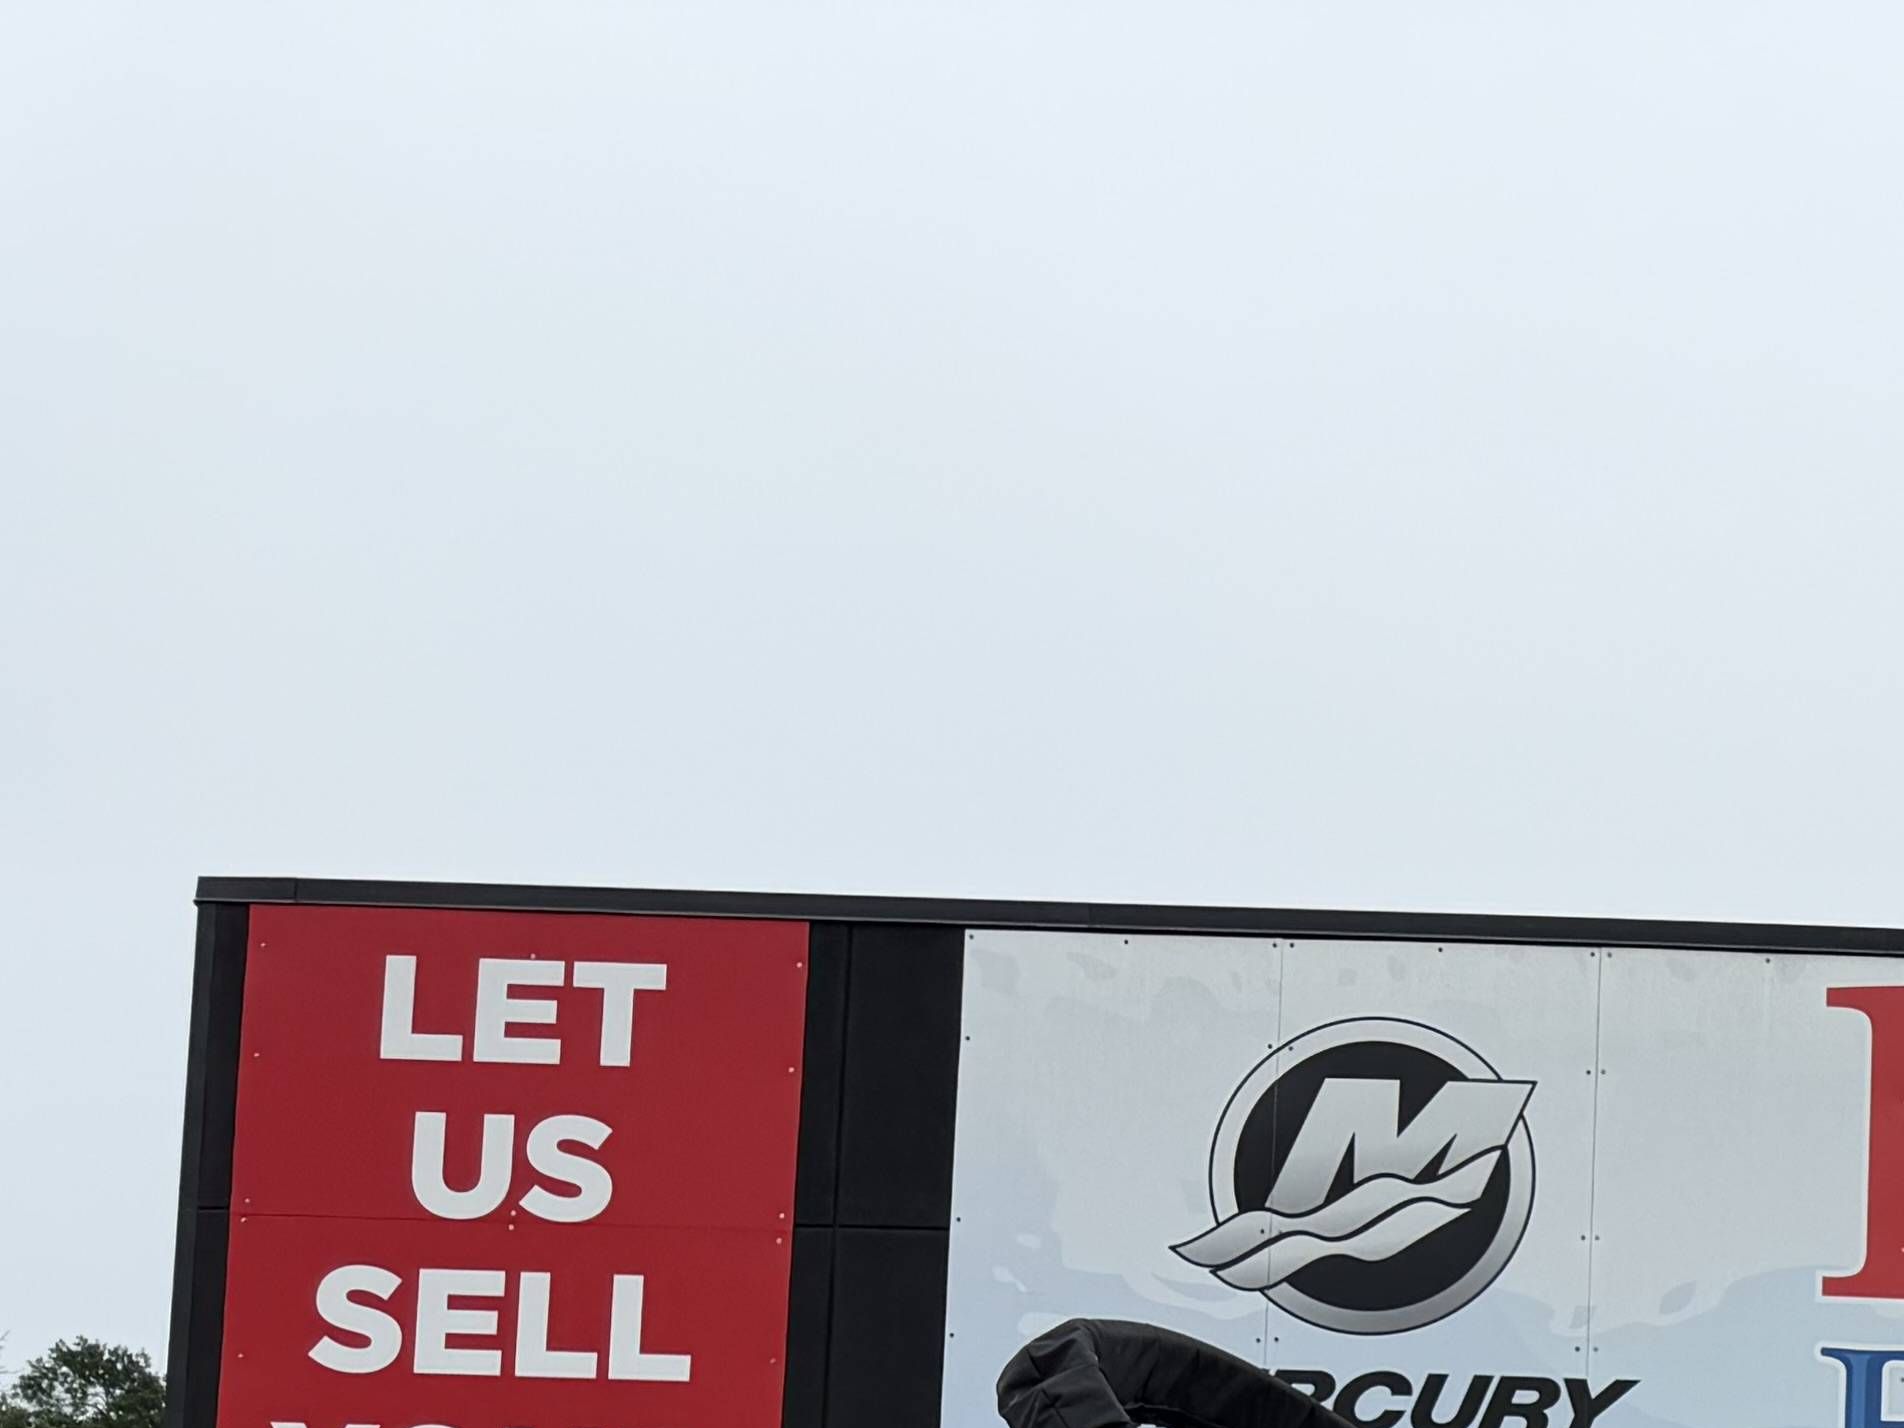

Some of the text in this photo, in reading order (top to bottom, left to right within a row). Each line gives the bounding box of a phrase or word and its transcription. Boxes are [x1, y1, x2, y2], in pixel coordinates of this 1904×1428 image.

[380, 954, 667, 1067] LET
[411, 1111, 614, 1223] US
[308, 1265, 691, 1382] SELL
